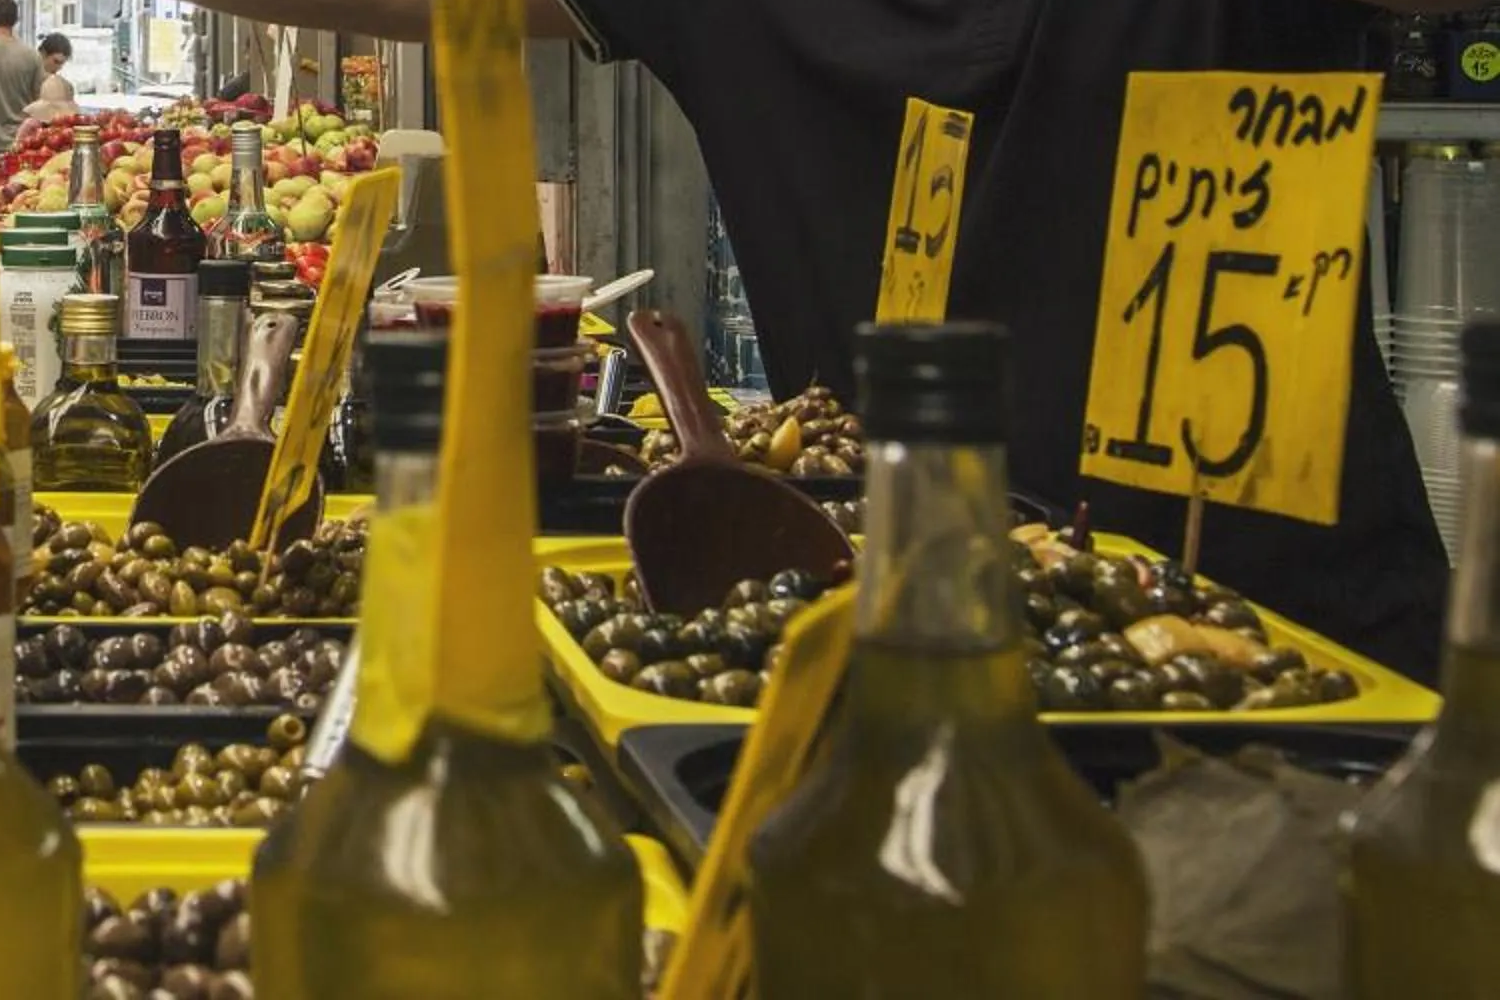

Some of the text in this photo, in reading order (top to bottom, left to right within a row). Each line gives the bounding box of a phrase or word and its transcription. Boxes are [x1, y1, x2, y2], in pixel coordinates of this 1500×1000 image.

[1227, 84, 1368, 149] מבחר
[1126, 152, 1274, 239] זיתים
[1105, 242, 1282, 478] 15
